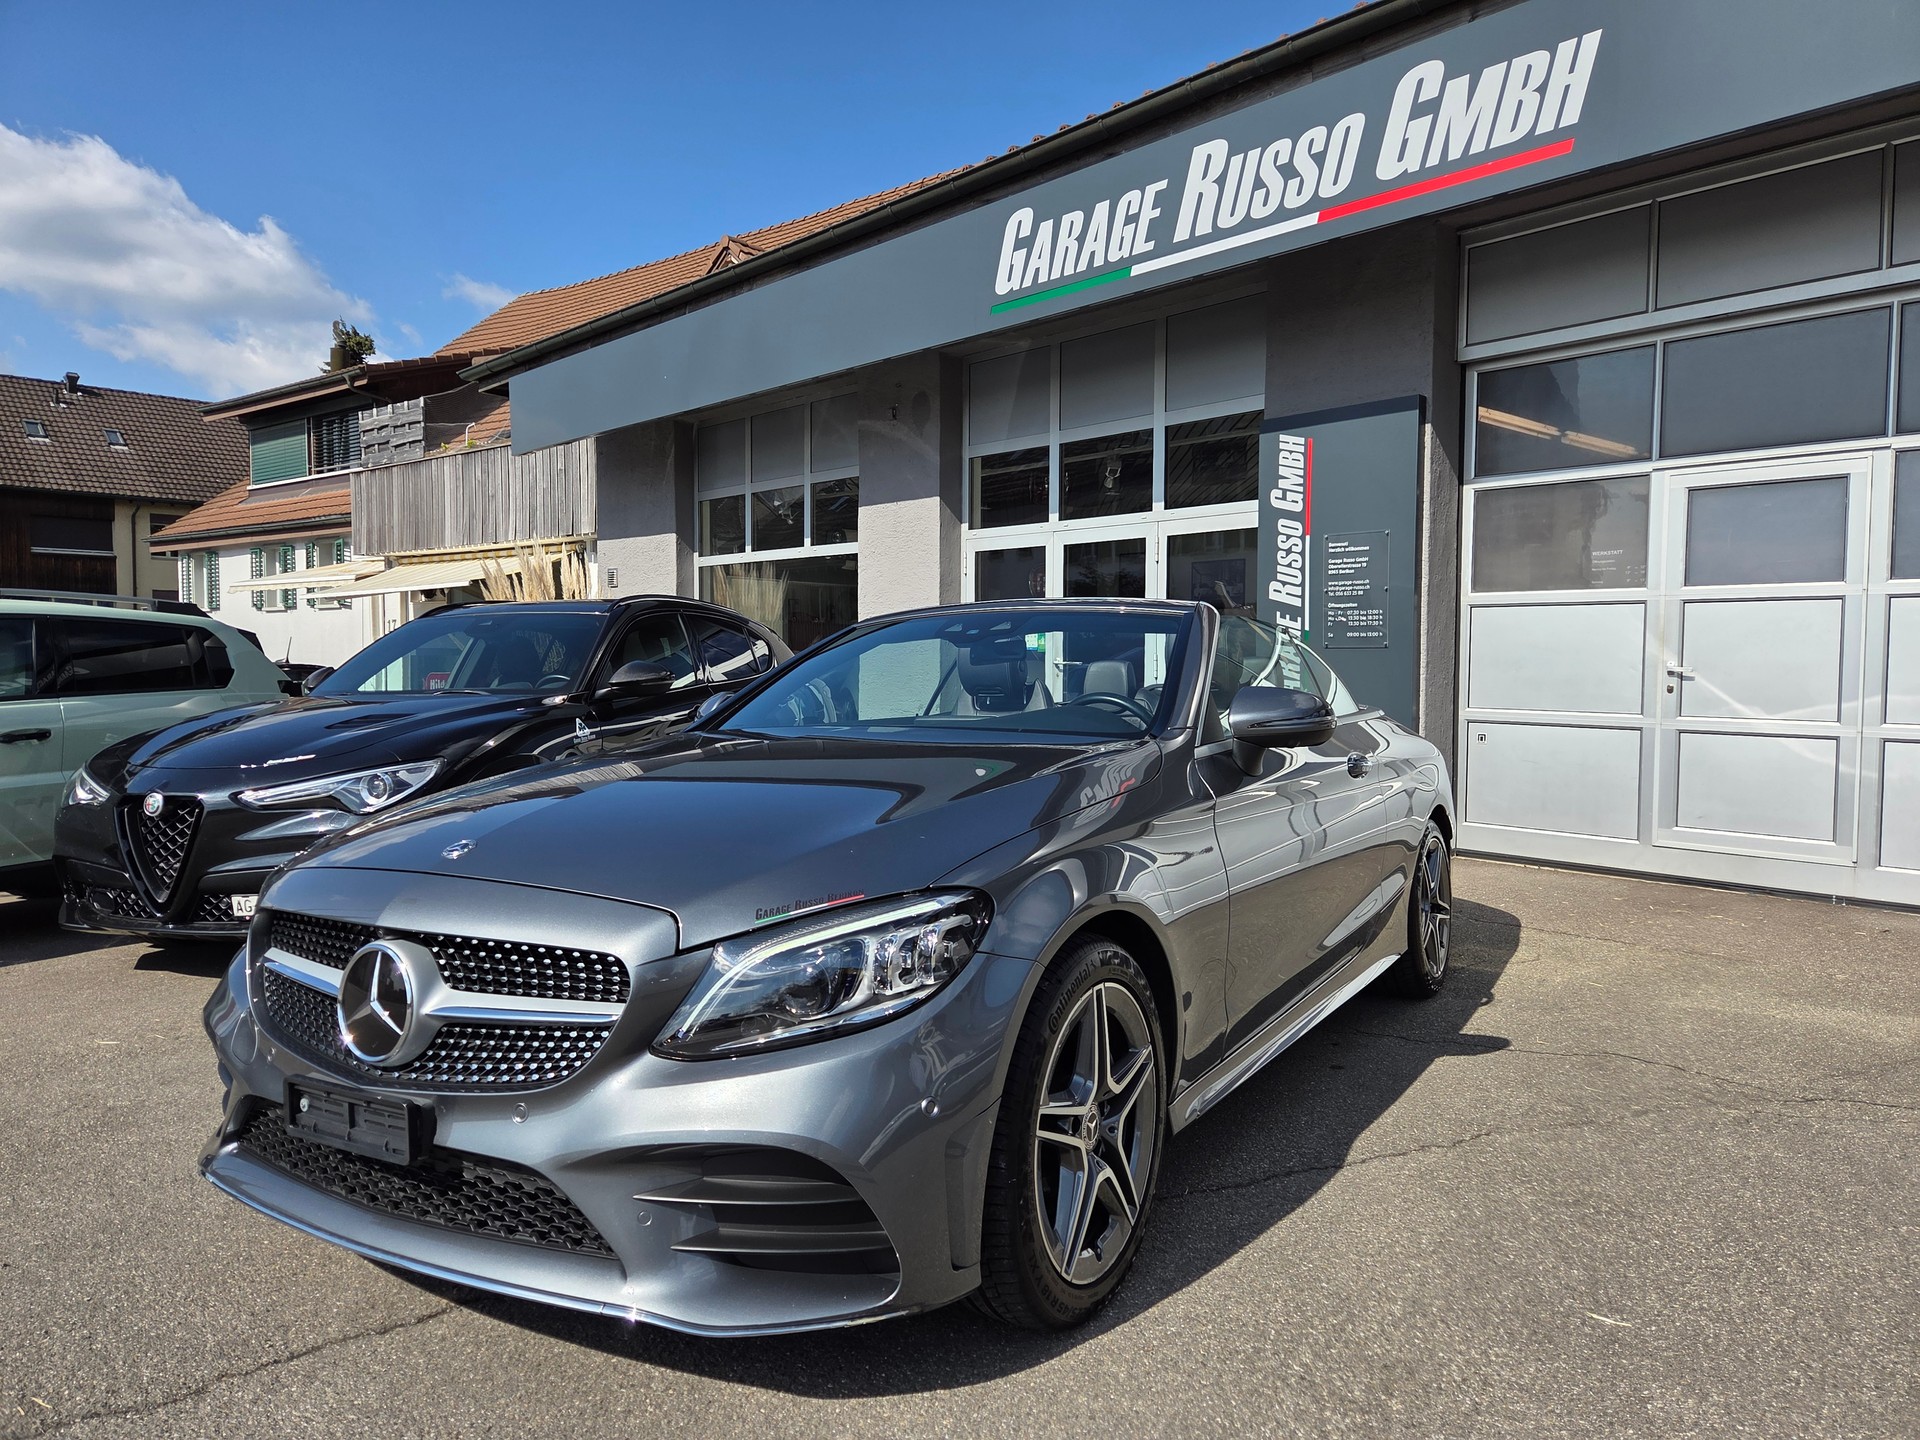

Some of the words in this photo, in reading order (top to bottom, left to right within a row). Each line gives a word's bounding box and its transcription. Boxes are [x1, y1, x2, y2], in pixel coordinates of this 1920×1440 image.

[994, 179, 1169, 295] GARAGE
[1173, 112, 1365, 244] RUSSO
[1376, 28, 1603, 182] GMBH
[1270, 434, 1305, 512] GMBH
[1268, 518, 1303, 608] RUSSO
[237, 899, 253, 914] AG
[755, 904, 791, 920] GARAGE
[794, 897, 824, 910] RUSSO
